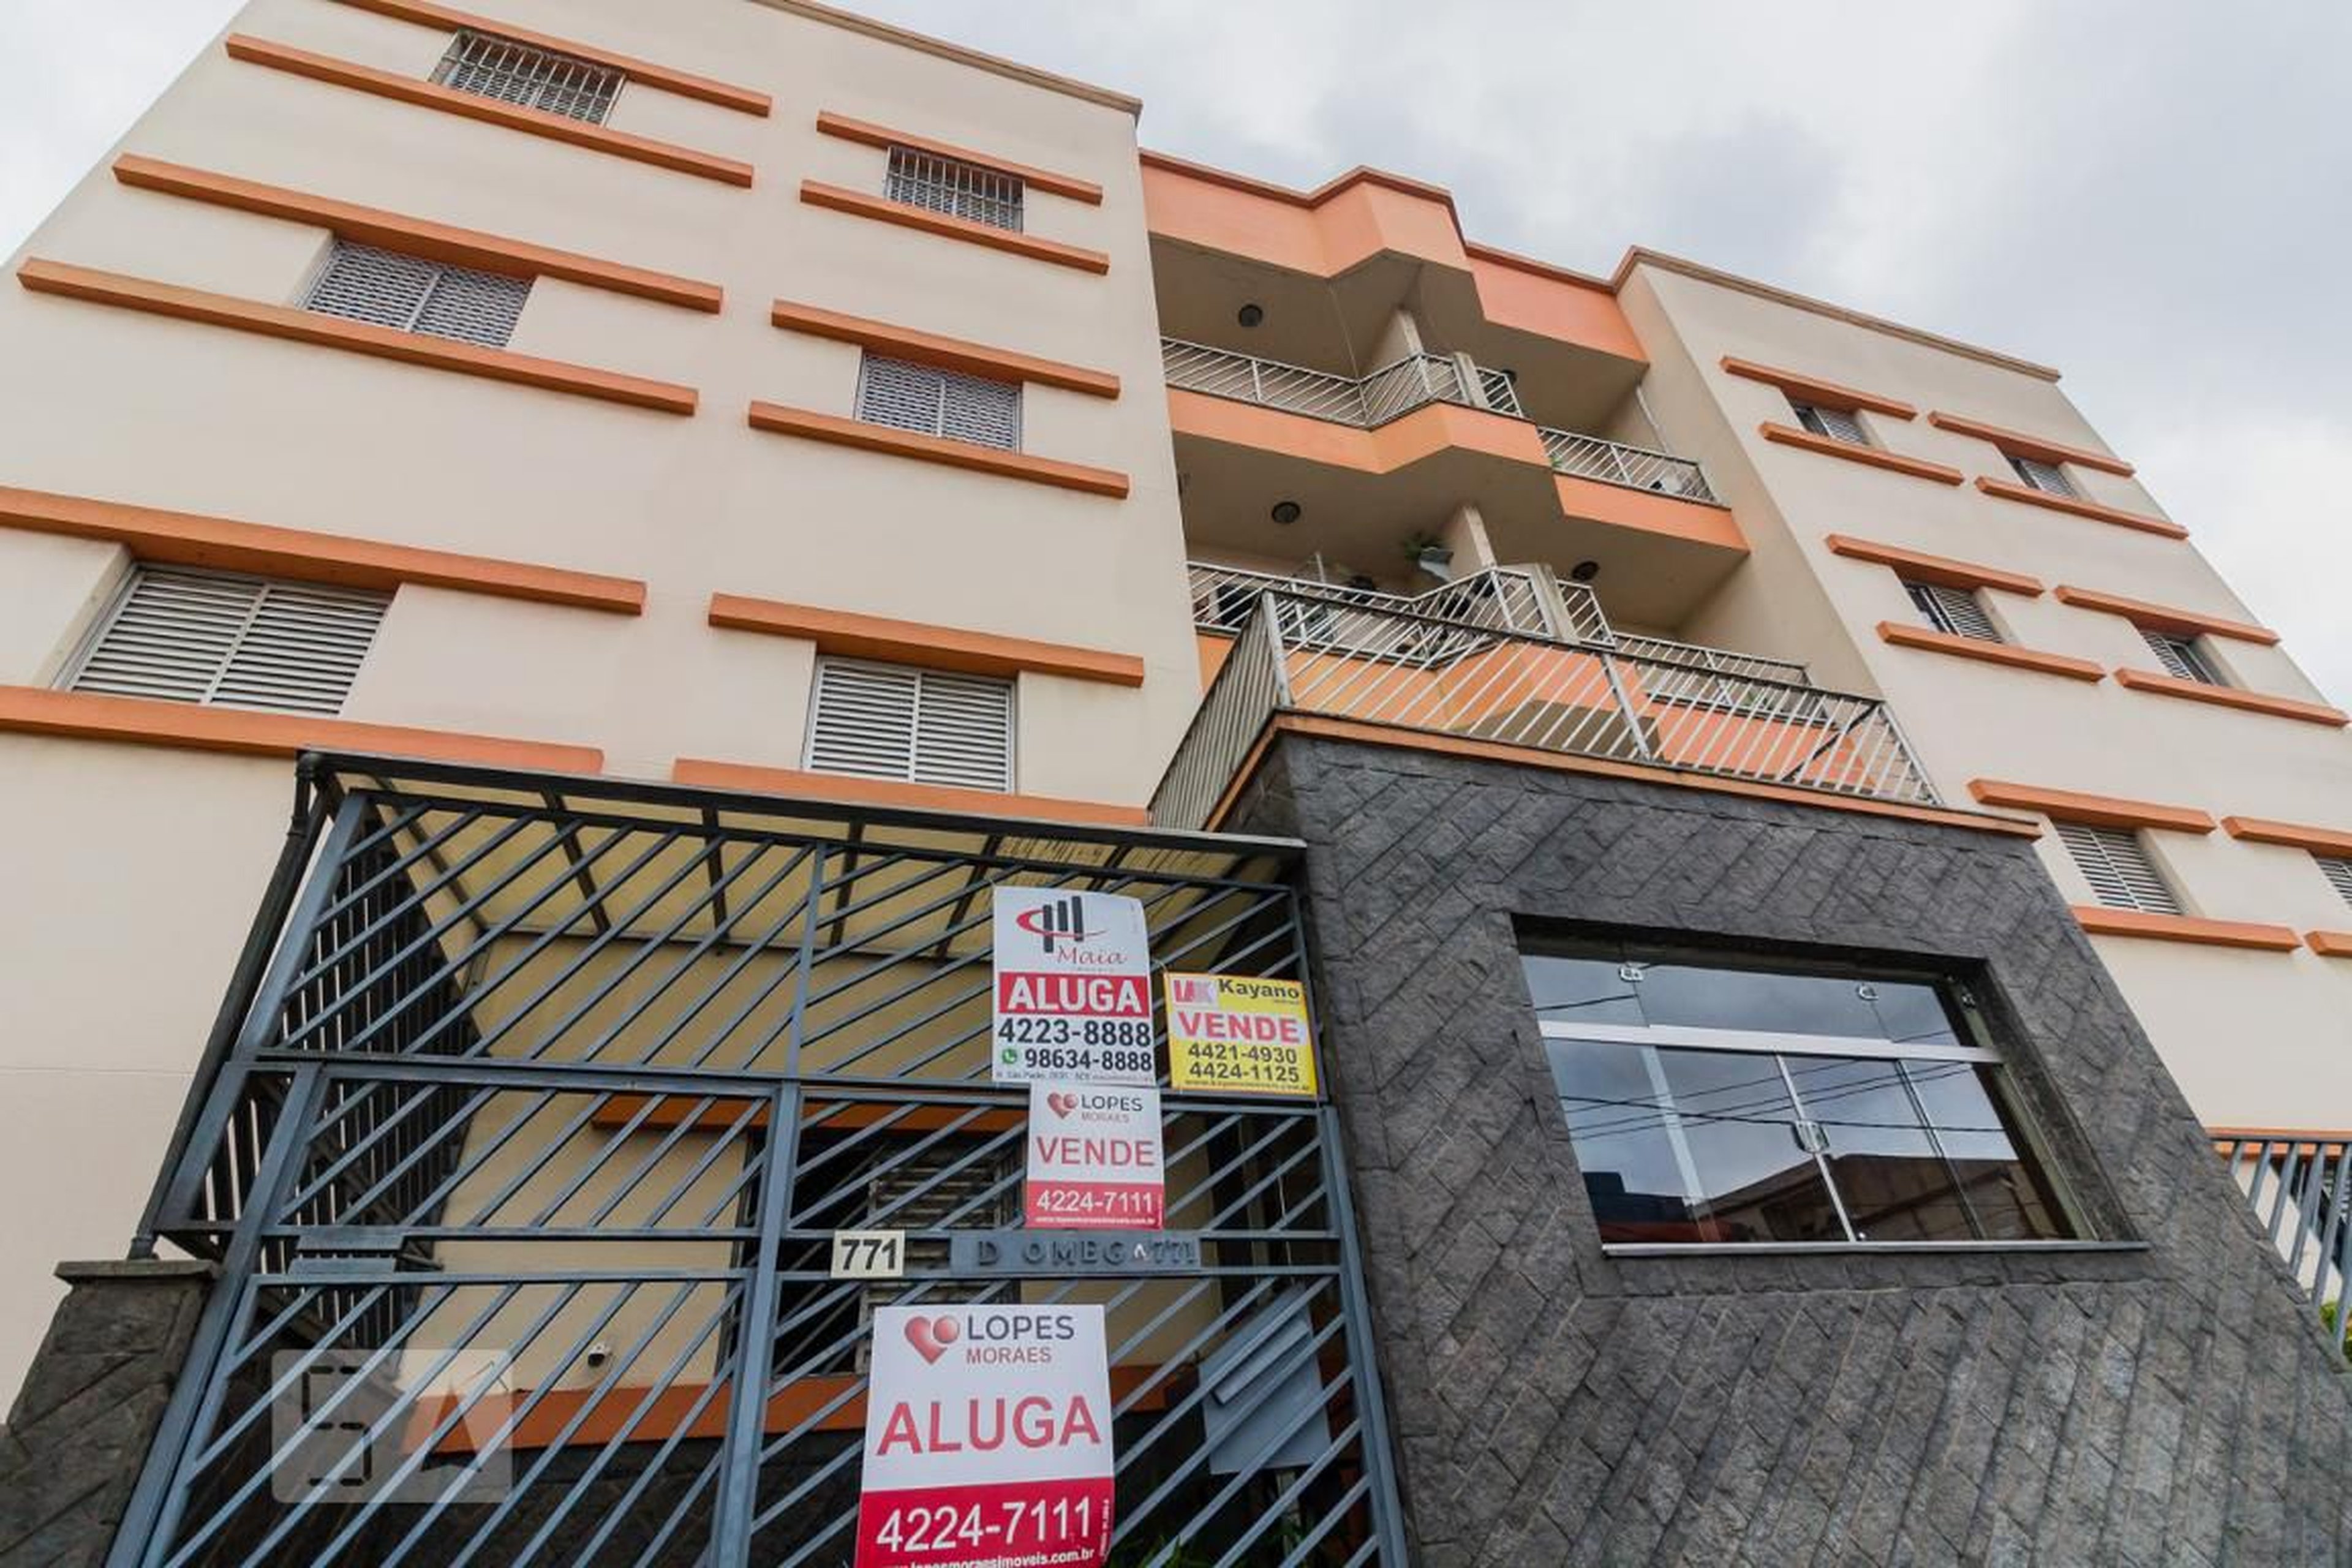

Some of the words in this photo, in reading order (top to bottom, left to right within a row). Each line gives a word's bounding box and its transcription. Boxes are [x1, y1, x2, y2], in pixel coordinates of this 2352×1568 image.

[1057, 944, 1129, 966] Maia
[1007, 976, 1142, 1013] ALUGA
[1218, 978, 1300, 999] Kayano
[998, 1017, 1152, 1047] 4223-8888
[1178, 1011, 1300, 1044] VENDE
[1024, 1048, 1152, 1072] 98634-8888
[1188, 1042, 1297, 1065] 4421-4930
[1189, 1061, 1300, 1083] 4424-1125
[1081, 1094, 1144, 1112] LOPES
[1036, 1136, 1156, 1167] VENDE
[1036, 1189, 1153, 1213] 4224-7111
[841, 1238, 897, 1270] 771
[967, 1314, 1075, 1341] LOPES
[965, 1346, 1052, 1366] MORAES
[875, 1395, 1101, 1457] ALUGA
[876, 1496, 1091, 1553] 4224-7111
